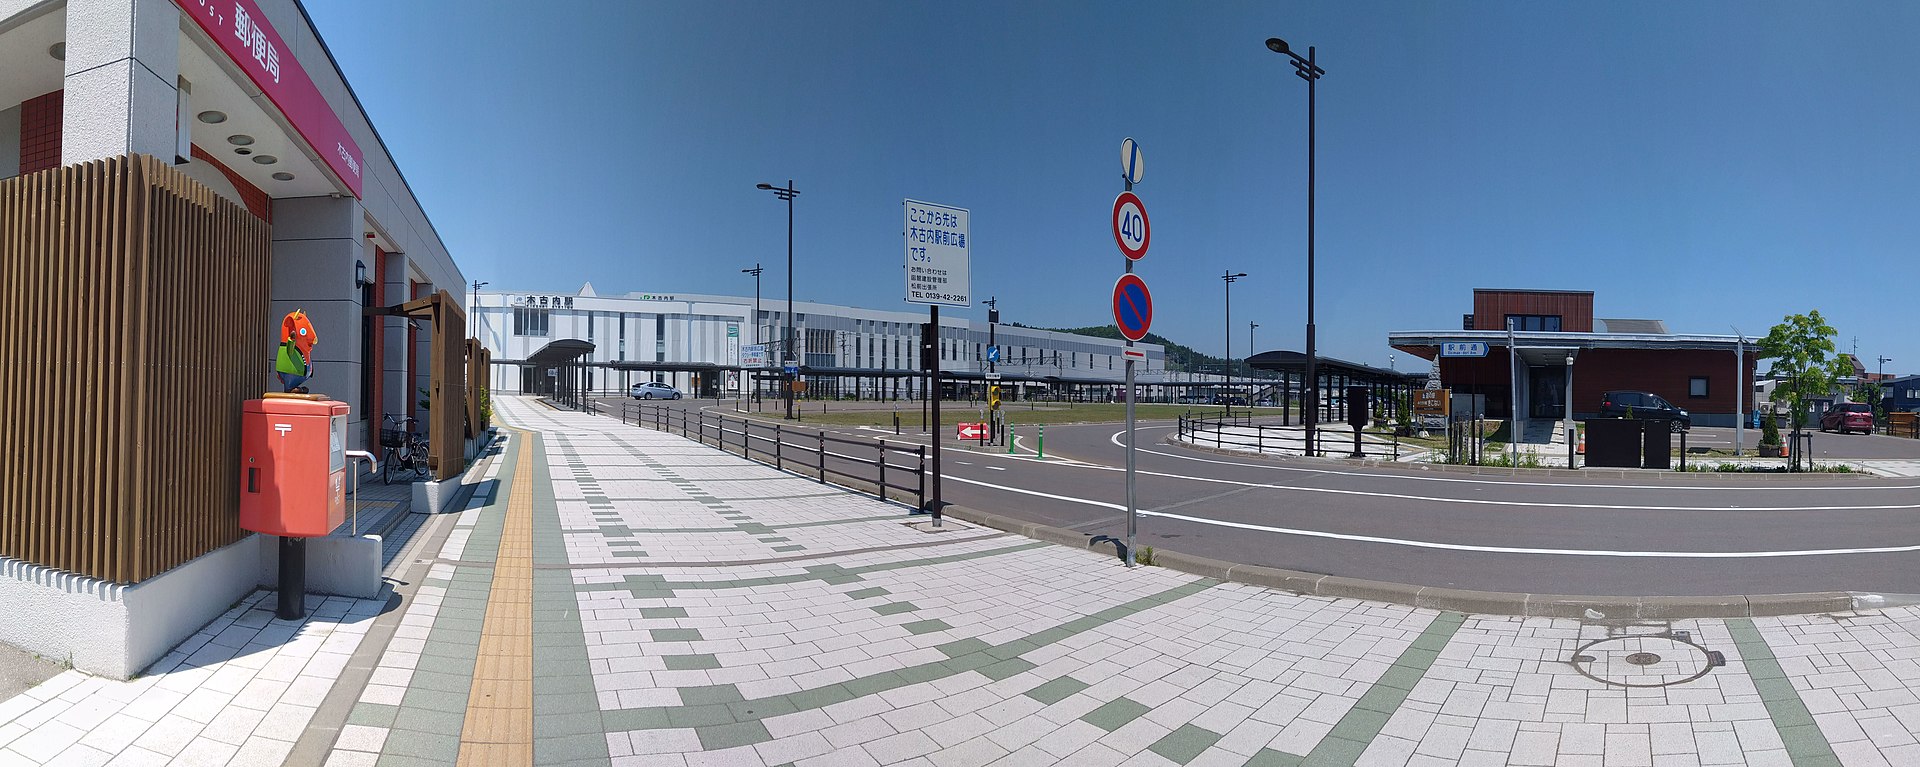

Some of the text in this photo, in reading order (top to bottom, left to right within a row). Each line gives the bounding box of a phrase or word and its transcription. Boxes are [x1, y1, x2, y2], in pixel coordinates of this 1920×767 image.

[235, 2, 279, 83] 郵便局
[910, 207, 958, 228] ここから先は
[1122, 211, 1142, 242] 40
[910, 226, 966, 249] 木古内駅前広場
[911, 247, 931, 263] です。
[911, 266, 947, 275] お問い合わせは
[527, 295, 573, 305] 木古内駅
[925, 292, 967, 302] 0139-42-2261
[1448, 343, 1477, 351] 駅前通
